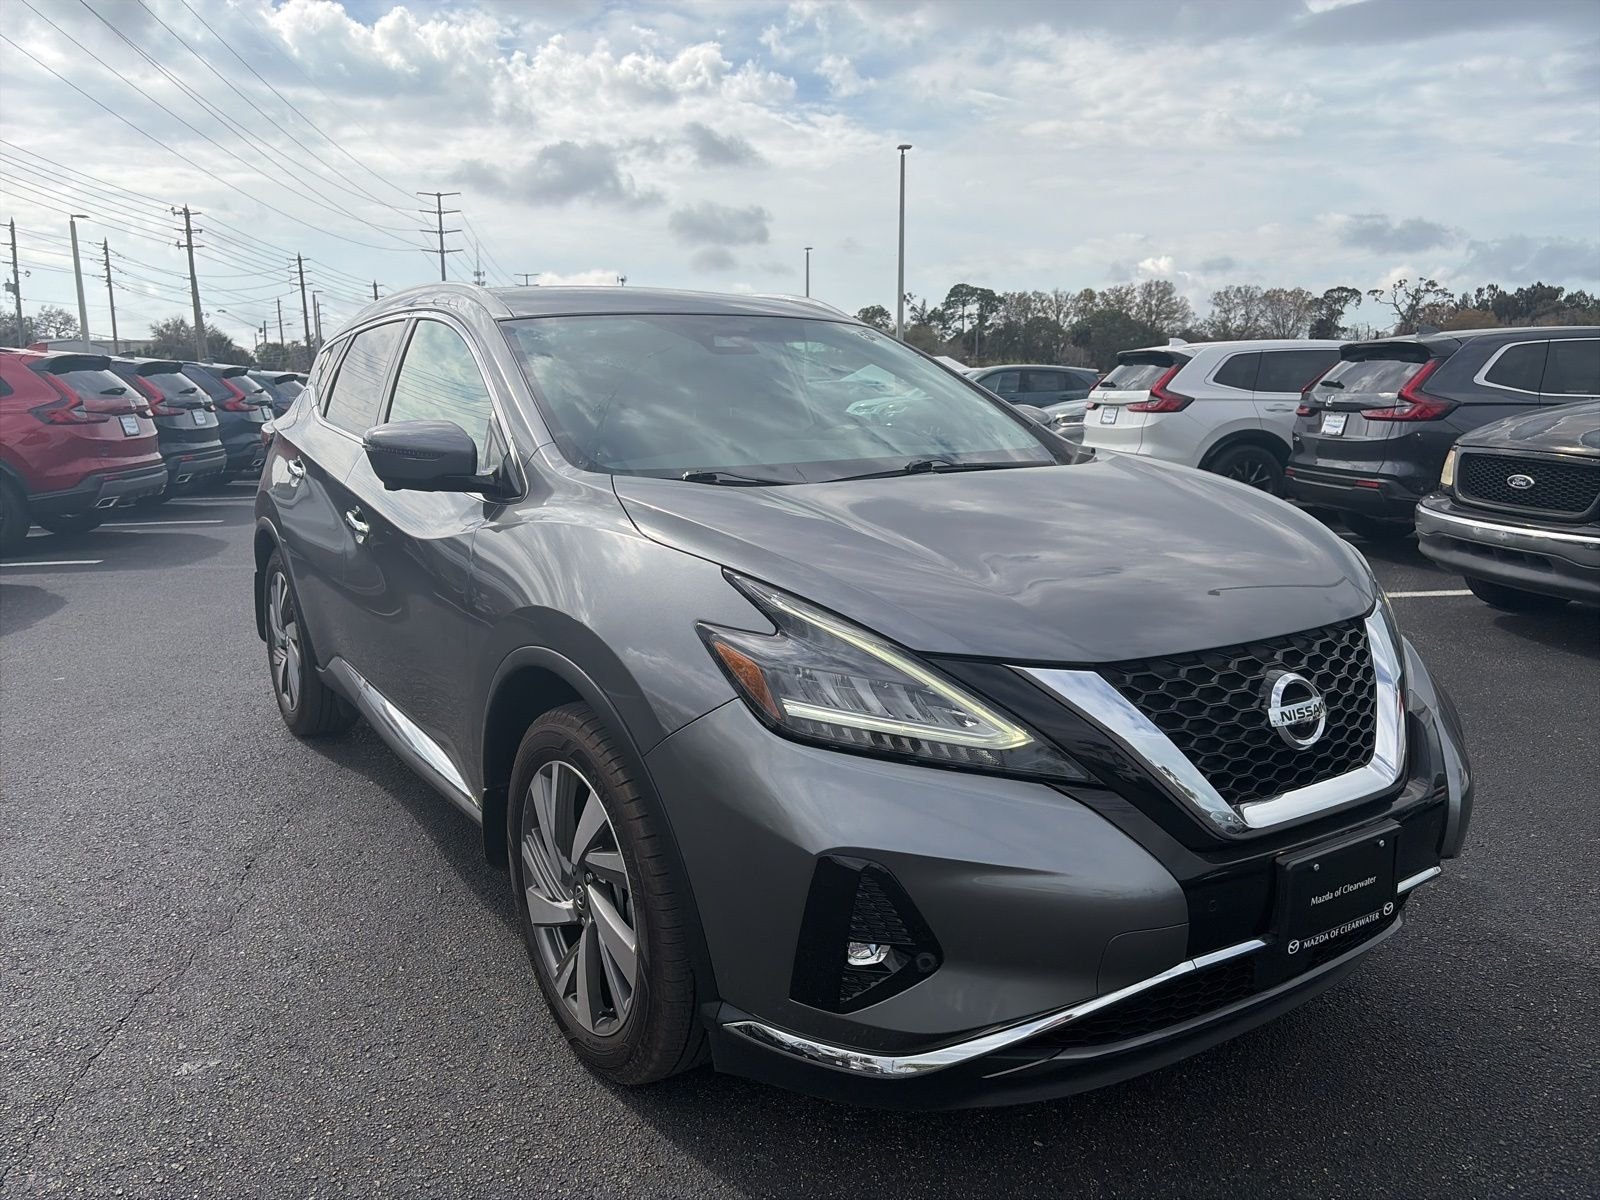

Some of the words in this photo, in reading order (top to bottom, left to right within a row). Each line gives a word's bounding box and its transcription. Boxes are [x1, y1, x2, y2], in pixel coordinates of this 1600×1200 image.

[1280, 702, 1326, 722] NISSAN
[1311, 891, 1333, 906] Mazda
[1334, 886, 1342, 897] of
[1343, 876, 1376, 894] Clearwater
[1303, 933, 1328, 949] MAZDA
[1330, 928, 1340, 939] OF
[1340, 912, 1379, 934] CLEARWATER
